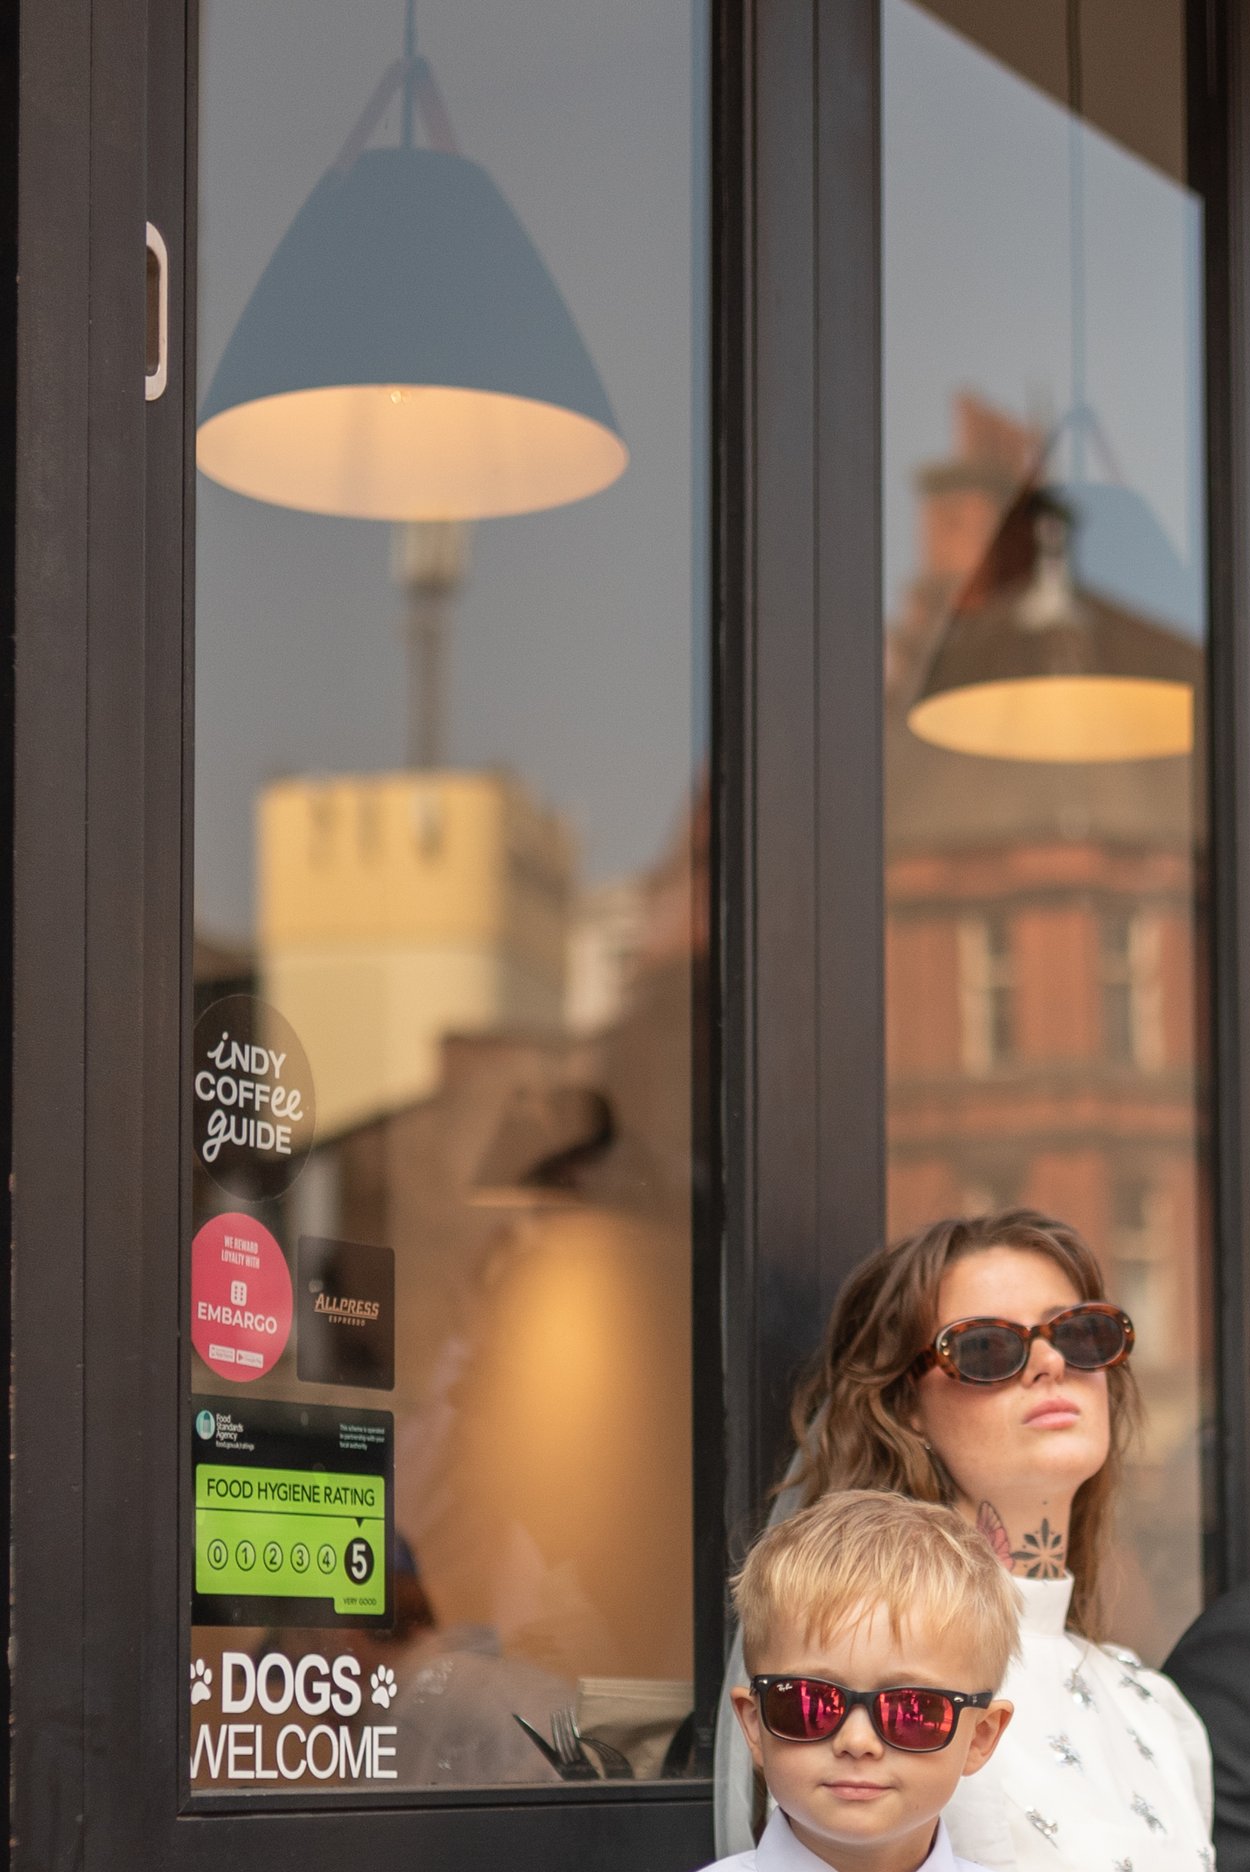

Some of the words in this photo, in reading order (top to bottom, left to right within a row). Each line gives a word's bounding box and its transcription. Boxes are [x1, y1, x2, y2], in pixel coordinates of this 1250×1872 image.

[221, 1249, 244, 1266] LOYALTY
[197, 1301, 277, 1335] EMBARGO
[314, 1293, 380, 1318] ALLPRESS
[328, 1315, 366, 1327] ESPRESSO
[215, 1413, 231, 1424] Food
[215, 1430, 238, 1442] Agency
[207, 1478, 253, 1499] FOOD
[258, 1482, 320, 1504] HYGIENE
[324, 1486, 375, 1507] RATING
[213, 1546, 222, 1564] 0
[269, 1548, 277, 1565] 2
[296, 1550, 304, 1567] 3
[322, 1550, 330, 1568] 4
[351, 1543, 367, 1580] 5
[343, 1597, 358, 1606] VERY
[359, 1597, 377, 1606] GOOD
[222, 1652, 361, 1717] DOGS
[190, 1724, 398, 1780] WELCOME
